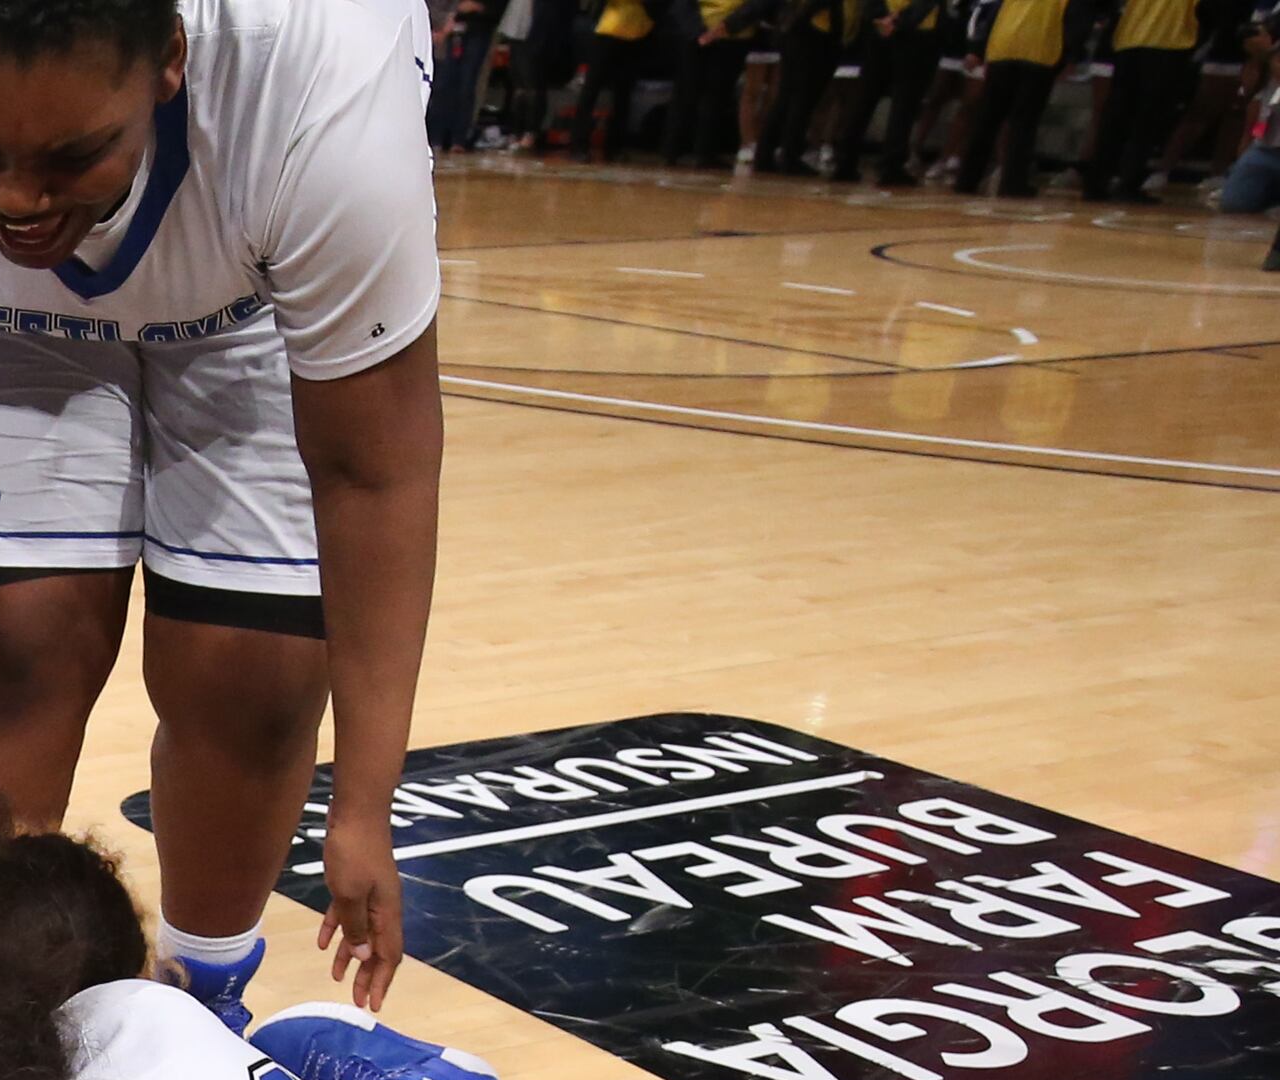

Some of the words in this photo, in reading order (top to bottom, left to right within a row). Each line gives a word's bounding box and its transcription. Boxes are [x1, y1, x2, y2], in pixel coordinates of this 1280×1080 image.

[291, 731, 820, 876] INSURAN
[463, 798, 1056, 934] BUREAU
[761, 851, 1233, 967] FARM
